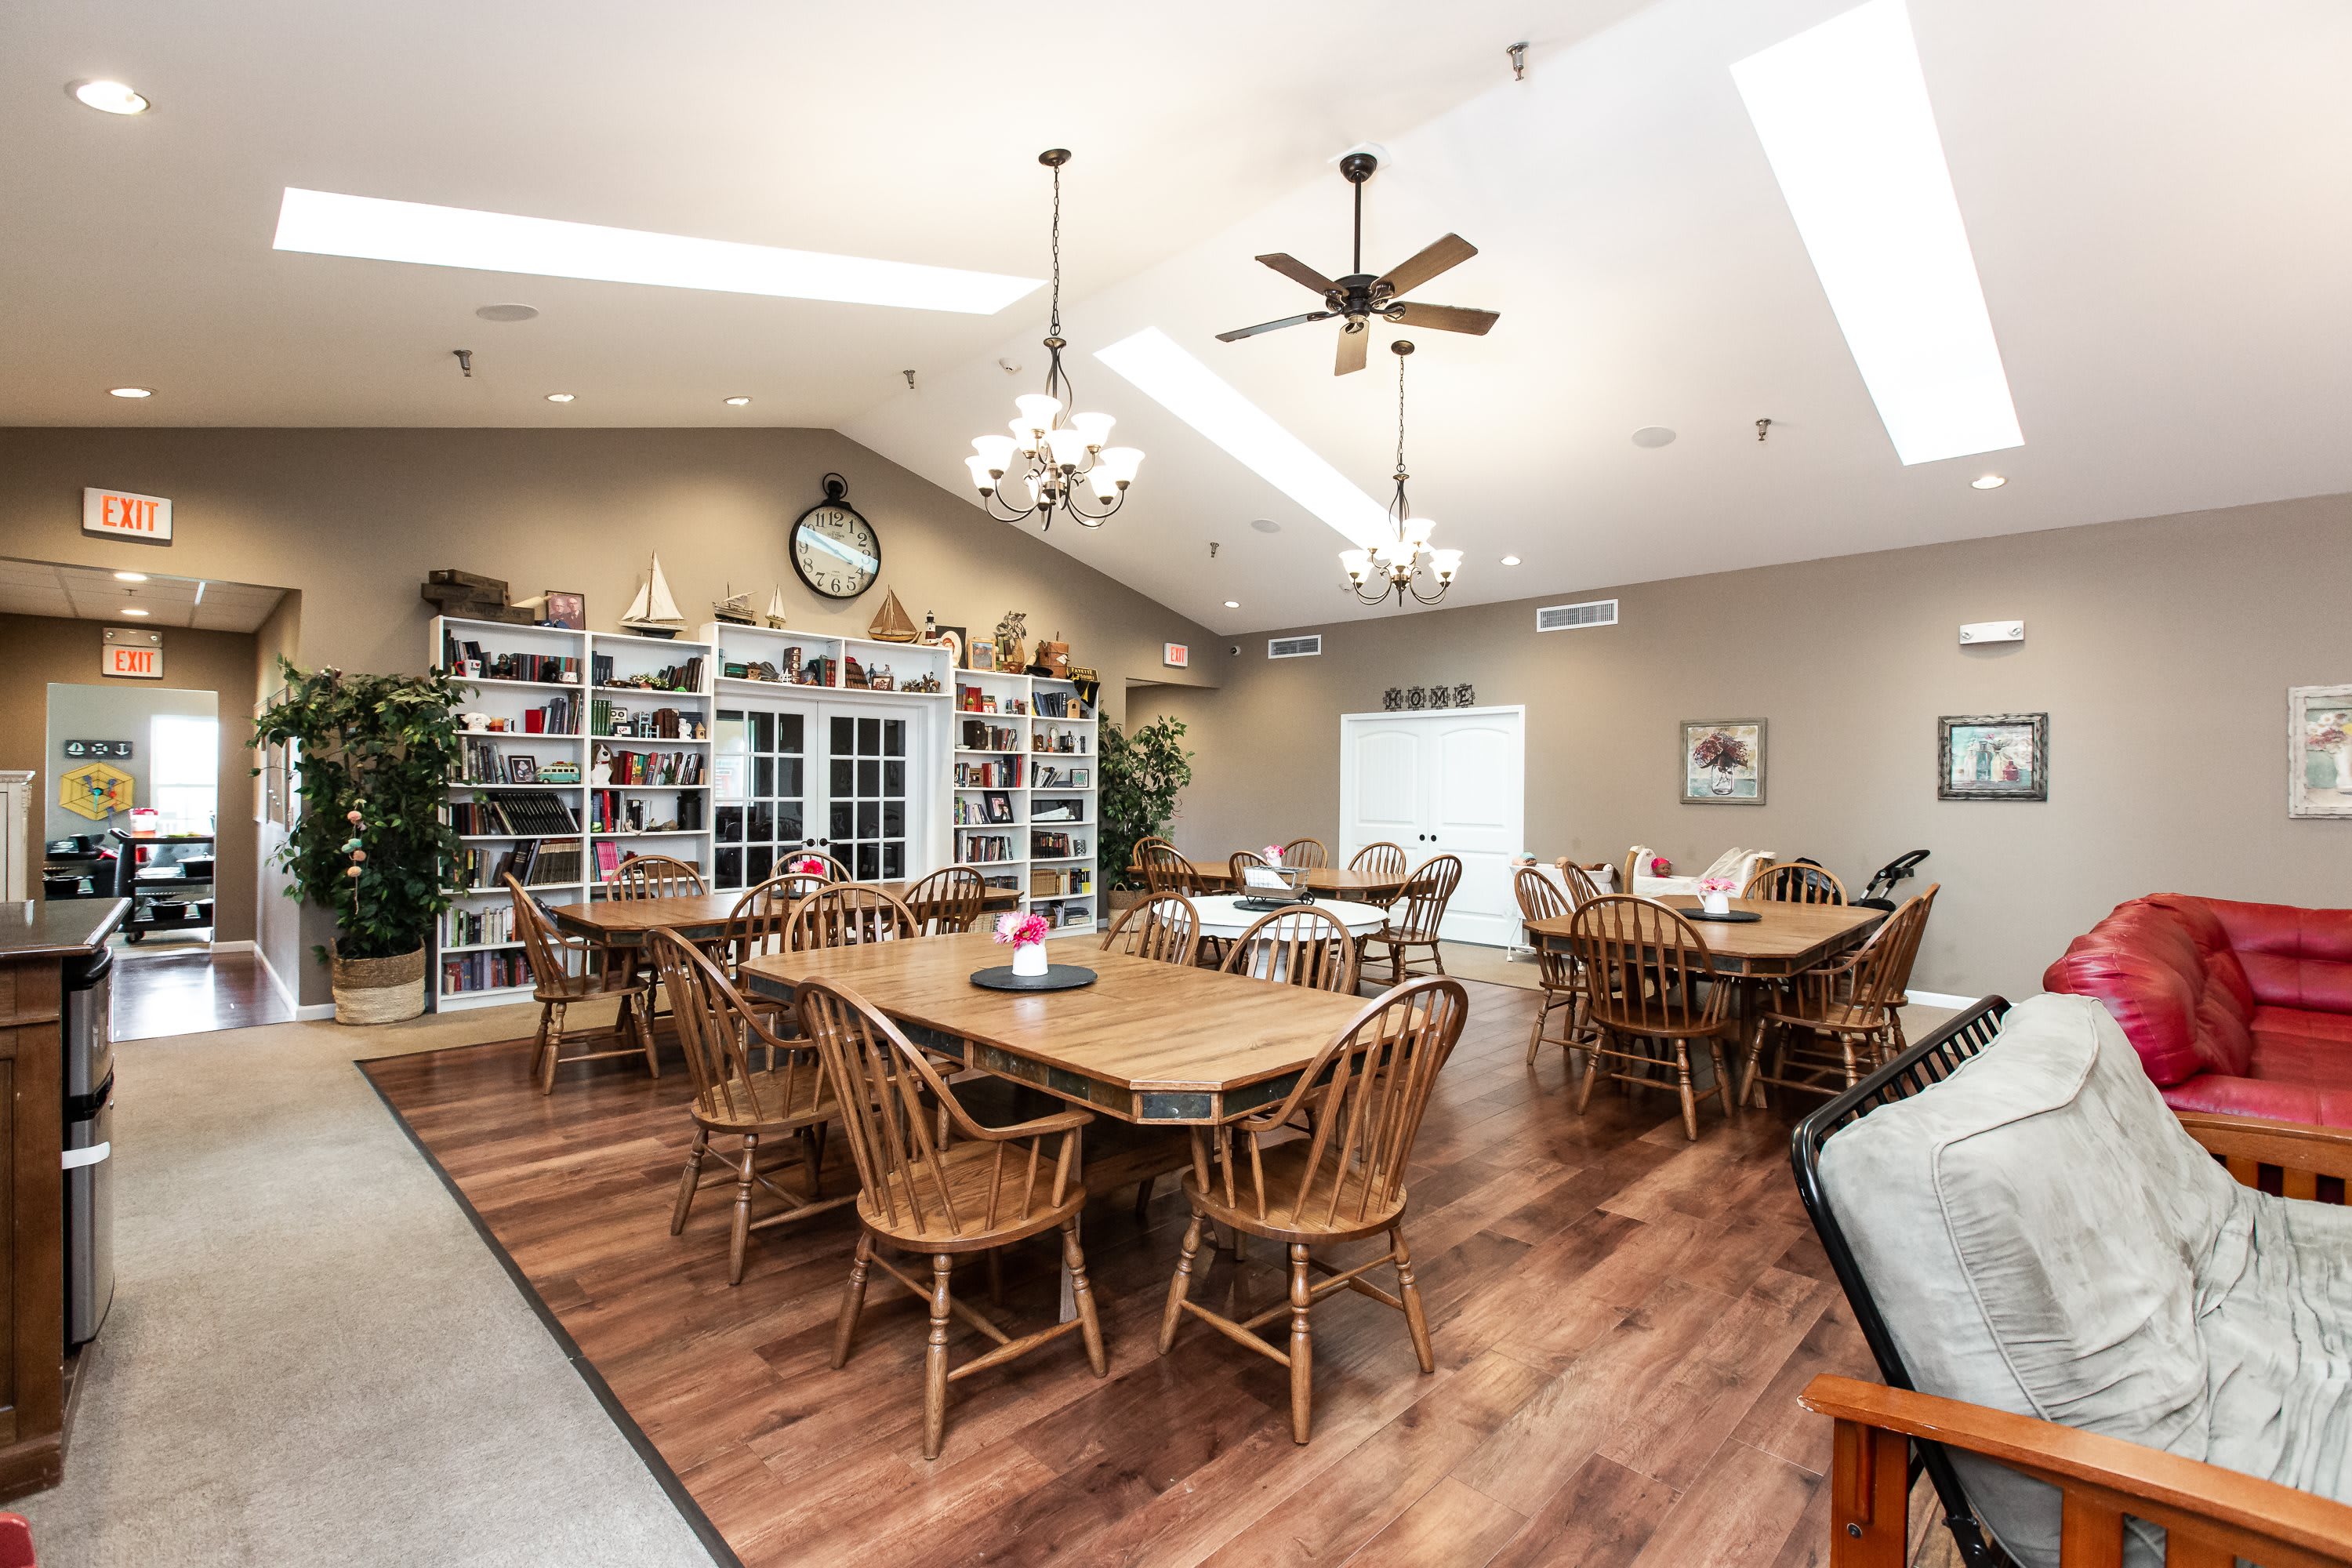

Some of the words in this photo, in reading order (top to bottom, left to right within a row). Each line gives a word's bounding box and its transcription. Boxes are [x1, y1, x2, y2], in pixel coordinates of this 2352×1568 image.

[101, 495, 158, 532] EXIT
[815, 512, 825, 528] 11
[829, 511, 844, 528] 12
[848, 519, 855, 534] 1
[799, 540, 809, 554] 9
[857, 532, 868, 547] 2
[862, 549, 871, 565] 3
[803, 558, 814, 573] 8
[855, 565, 866, 580] 4
[815, 572, 826, 586] 7
[830, 578, 840, 593] 6
[847, 576, 856, 591] 5
[114, 650, 154, 673] EXIT
[1171, 646, 1185, 663] EXIT
[1385, 688, 1470, 708] HOME
